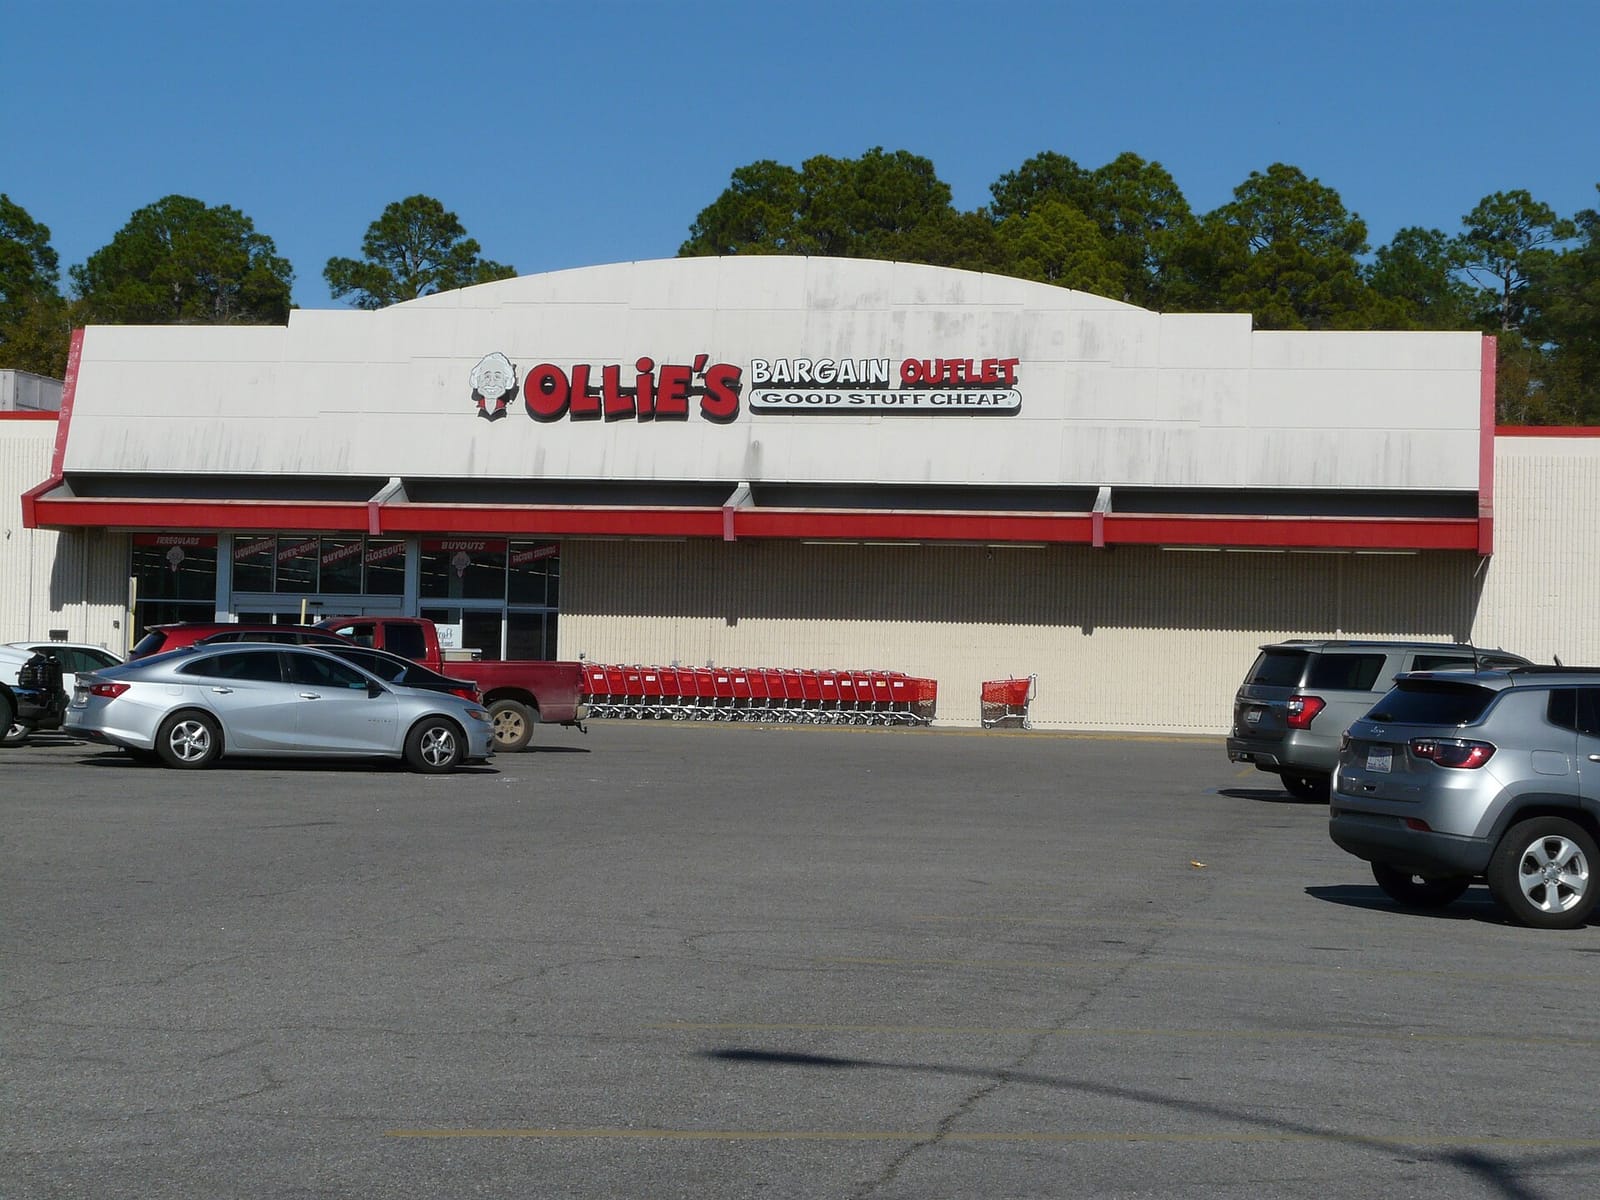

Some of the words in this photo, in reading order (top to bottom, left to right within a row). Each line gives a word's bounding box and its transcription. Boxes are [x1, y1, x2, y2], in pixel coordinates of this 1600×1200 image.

[751, 358, 890, 384] BARGAIN
[900, 358, 1020, 384] OUTLET
[755, 391, 842, 405] "GOOD
[848, 393, 926, 405] STUFF
[156, 535, 201, 545] IRREGULARS
[441, 541, 486, 551] BUYOUTS
[365, 542, 407, 563] CLOSEOUTS
